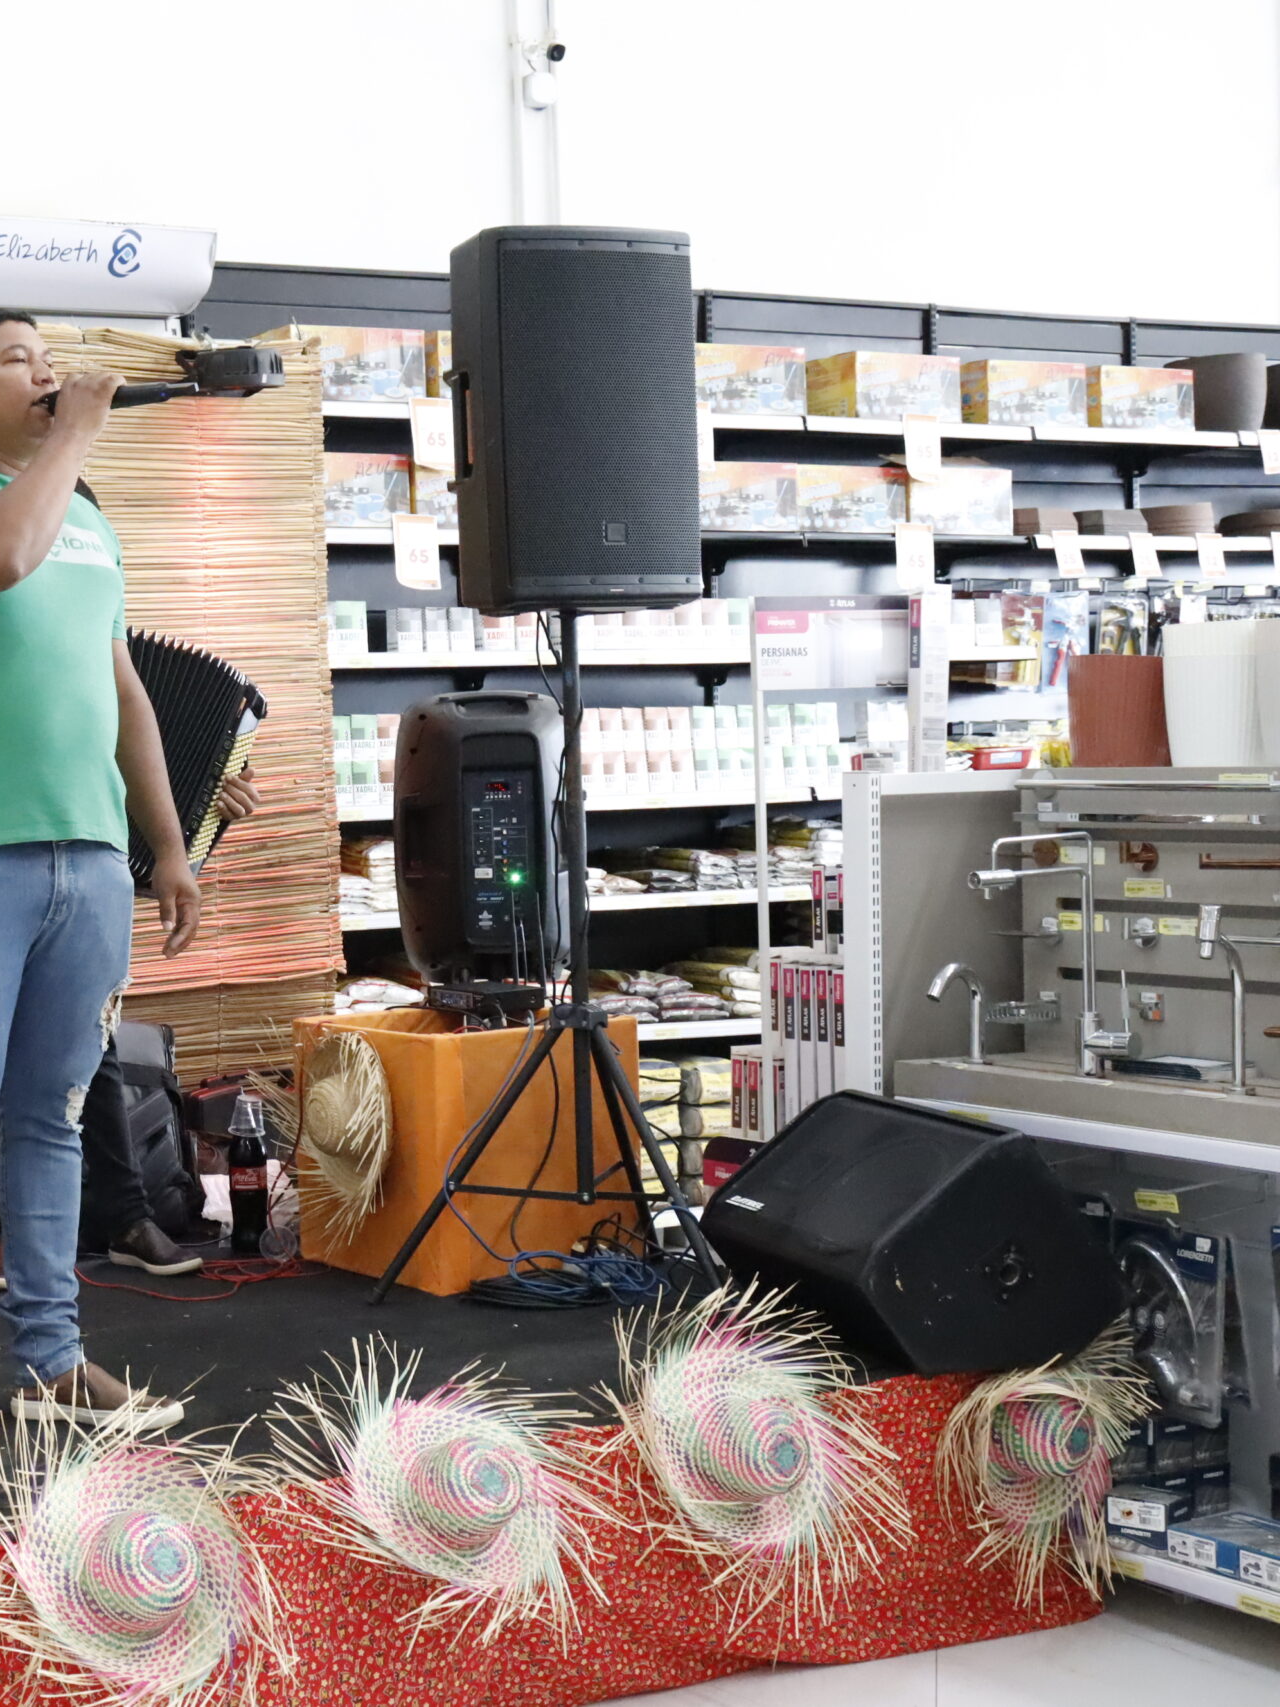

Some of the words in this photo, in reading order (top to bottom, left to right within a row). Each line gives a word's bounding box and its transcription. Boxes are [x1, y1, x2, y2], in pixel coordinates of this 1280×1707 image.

[426, 432, 447, 447] 65
[409, 550, 429, 563] 65
[836, 599, 856, 607] ATLAS
[761, 647, 808, 657] PERSIANAS
[355, 785, 377, 793] XADREZ
[1176, 1247, 1215, 1264] LORENZETTI
